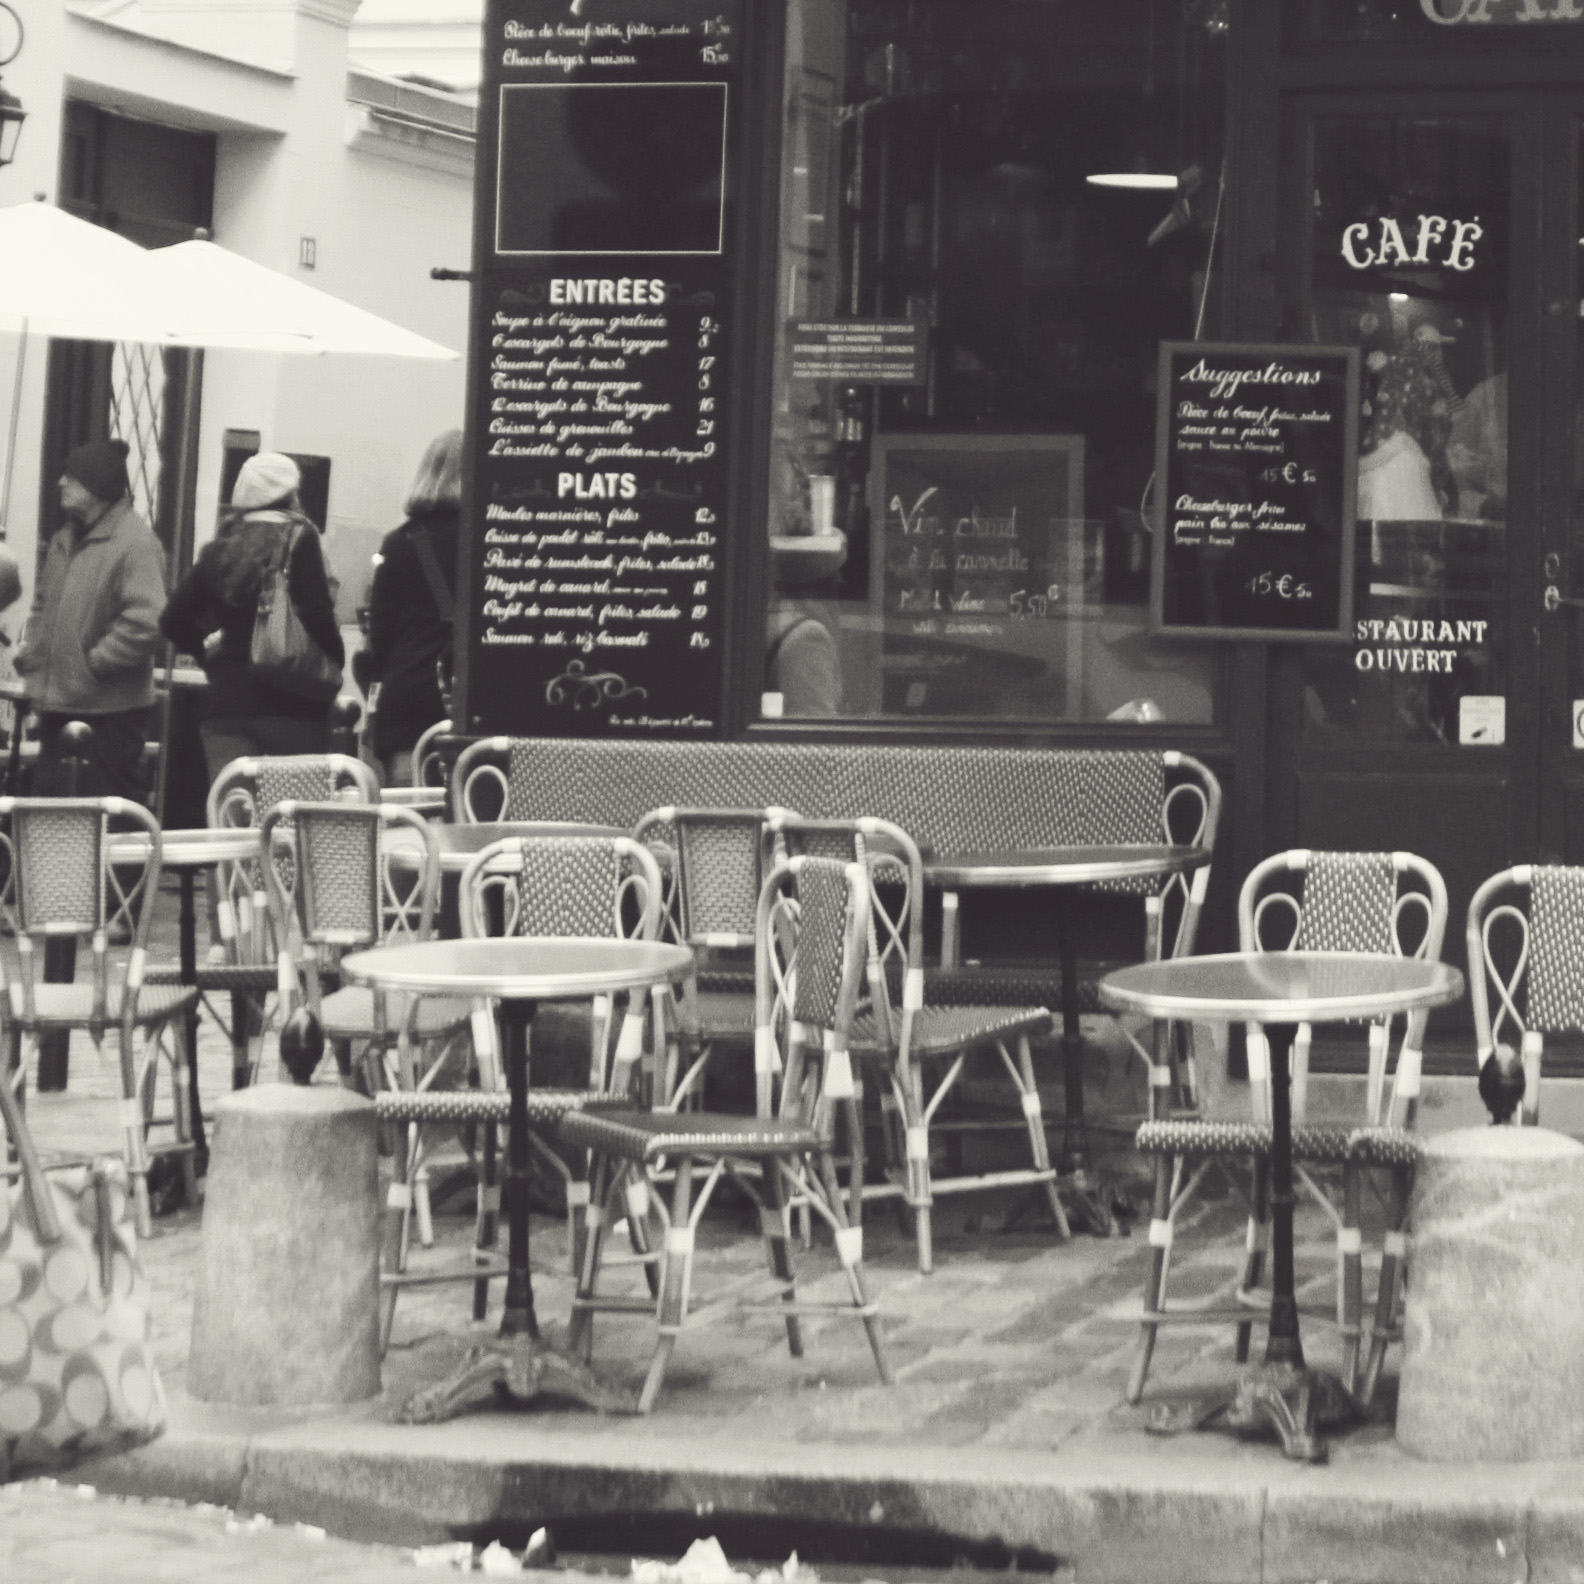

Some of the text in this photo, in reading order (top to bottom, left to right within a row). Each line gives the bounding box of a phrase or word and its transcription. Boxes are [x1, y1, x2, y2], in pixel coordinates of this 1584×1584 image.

[538, 23, 553, 38] de
[1341, 215, 1483, 270] CAFÉ
[569, 334, 586, 348] de
[588, 332, 668, 354] Bourgogne
[699, 356, 716, 370] 17
[551, 377, 569, 390] de
[1179, 357, 1321, 399] Suggestions
[570, 397, 588, 411] de
[592, 395, 671, 420] Bourgogne
[1213, 405, 1229, 419] de
[539, 420, 556, 434] de
[565, 442, 584, 456] de
[558, 472, 637, 499] PLATS
[521, 530, 537, 544] de
[524, 555, 542, 568] de
[539, 579, 556, 592] de
[524, 602, 541, 617] de
[1353, 620, 1488, 643] STAURANT
[1355, 649, 1456, 672] OUVERT
